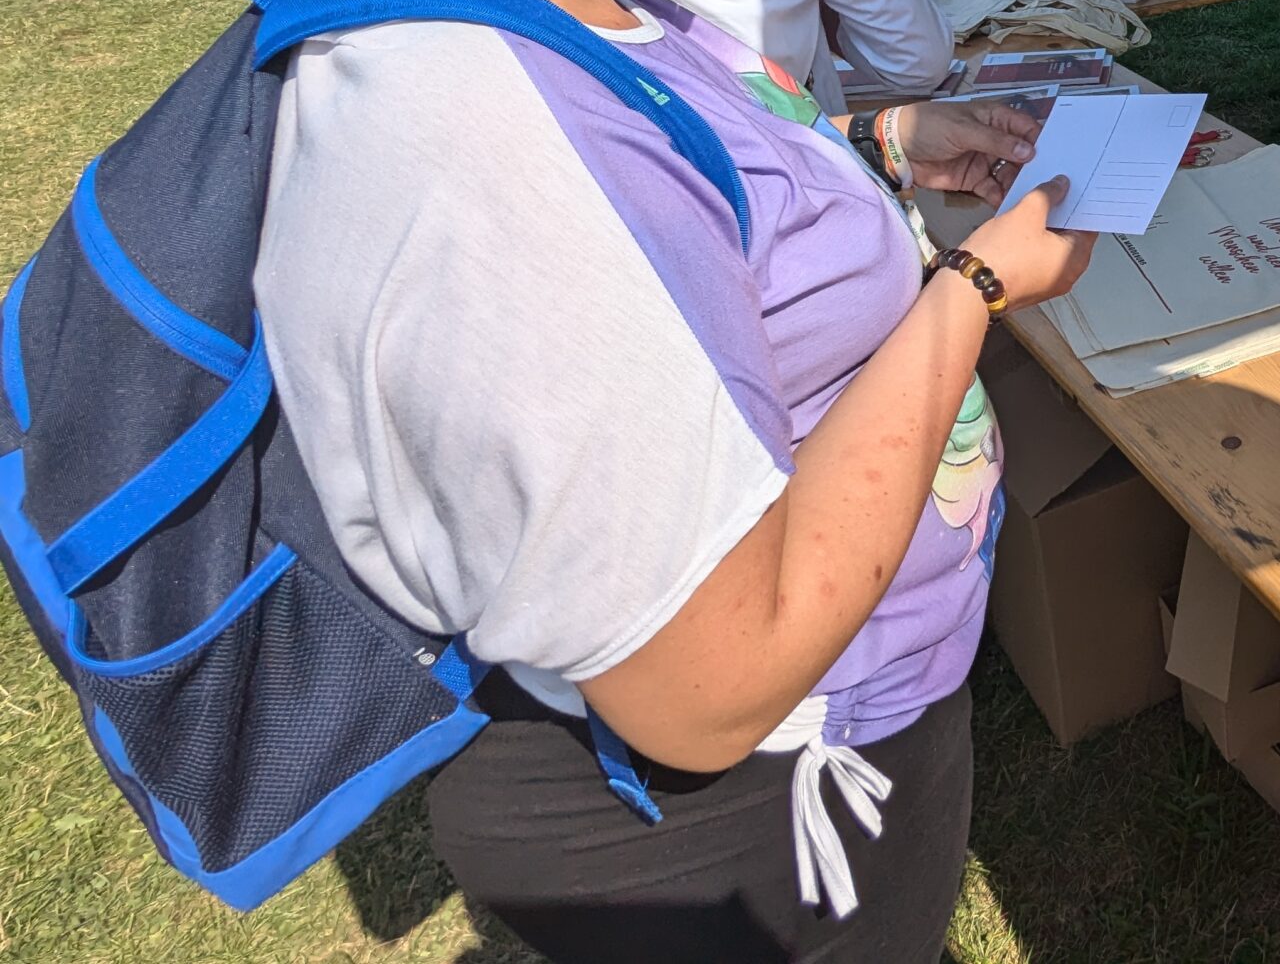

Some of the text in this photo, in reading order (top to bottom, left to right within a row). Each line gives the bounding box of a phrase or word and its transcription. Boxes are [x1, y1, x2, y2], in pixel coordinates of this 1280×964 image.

[887, 137, 902, 165] WEITER
[1208, 225, 1261, 274] Menschen
[1247, 234, 1280, 253] und
[1199, 255, 1236, 284] willen
